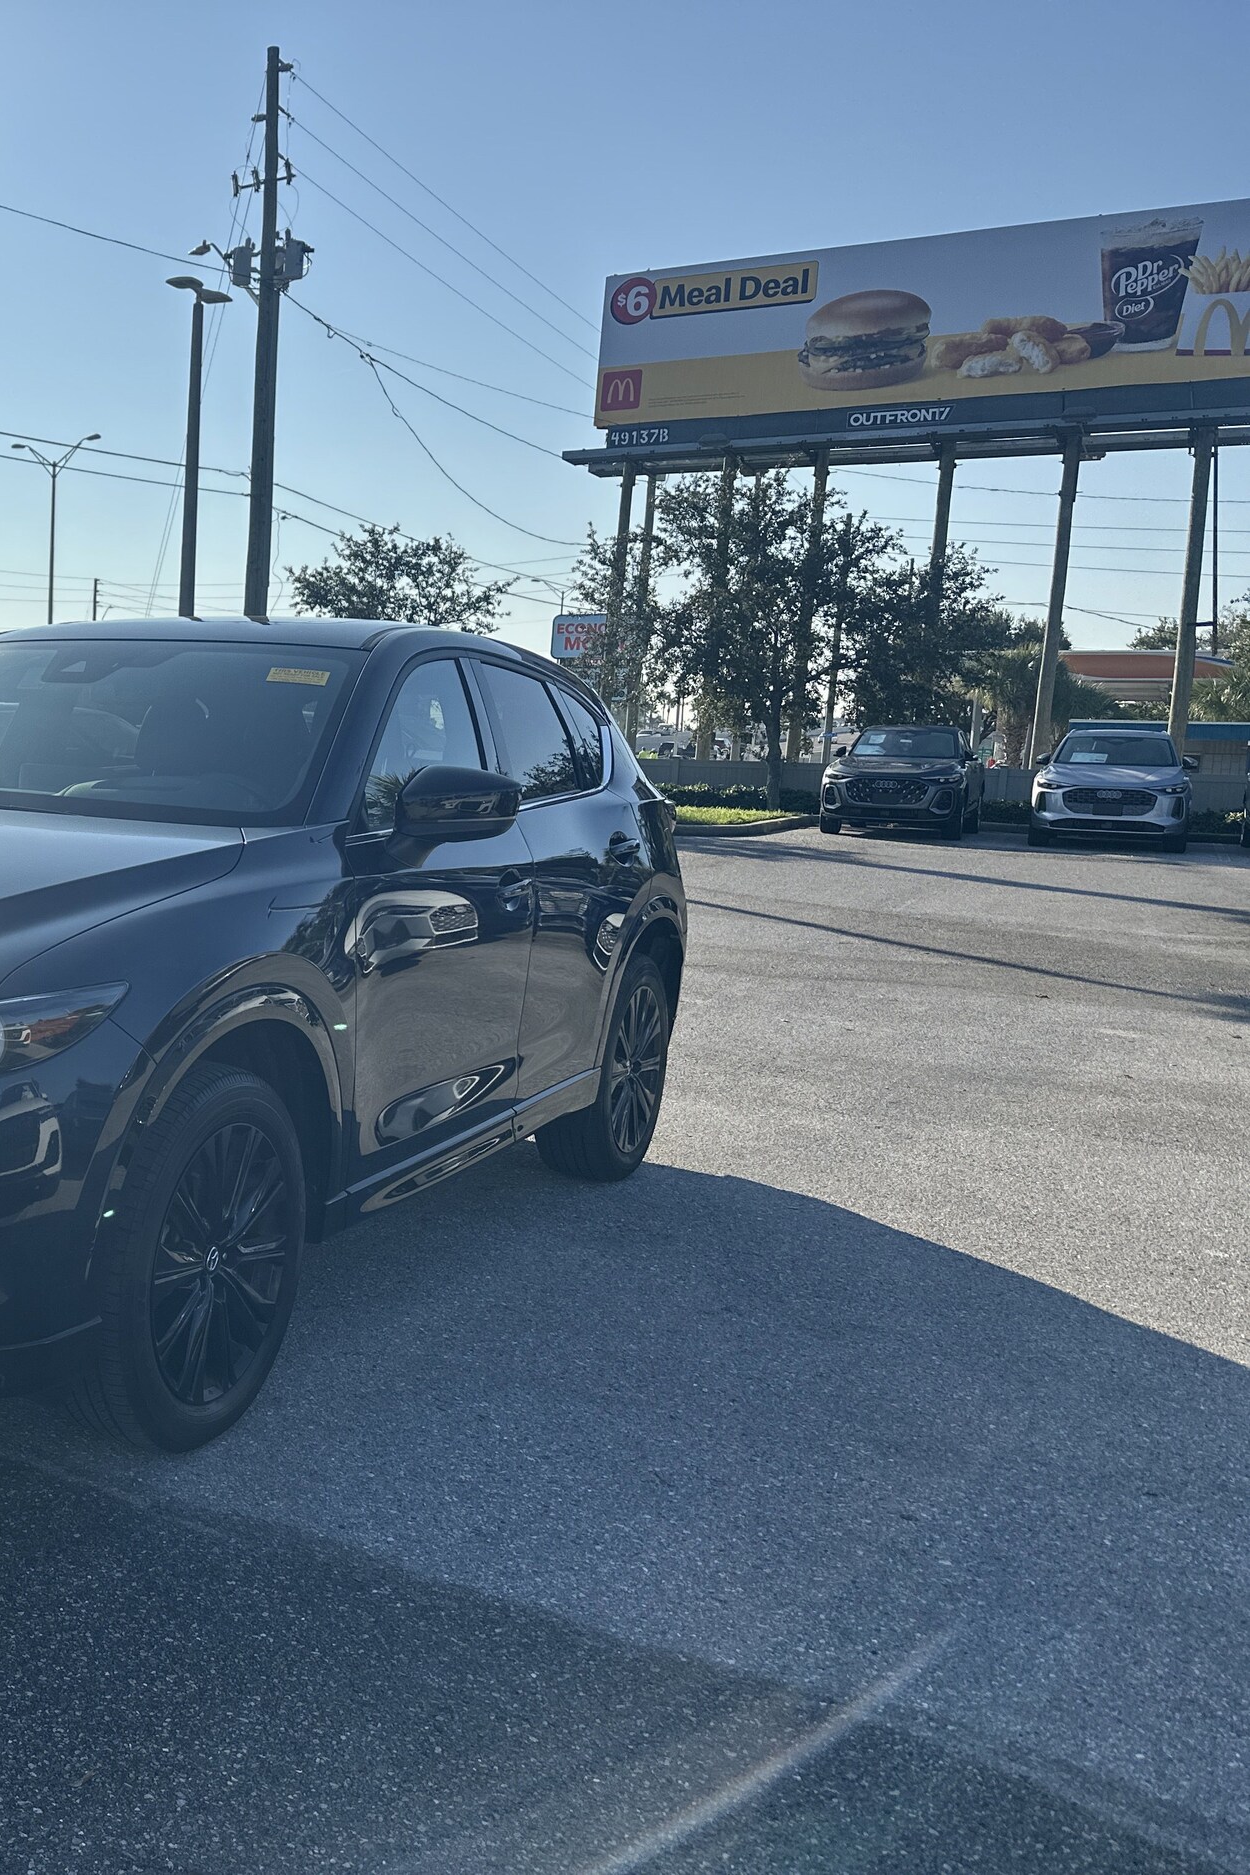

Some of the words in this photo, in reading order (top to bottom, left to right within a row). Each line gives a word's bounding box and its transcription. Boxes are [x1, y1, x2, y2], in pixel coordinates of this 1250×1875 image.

[1138, 260, 1163, 280] Dr
[1112, 263, 1179, 297] Pepper
[617, 285, 650, 317] $6
[658, 277, 732, 310] Meal
[738, 268, 810, 301] Deal
[1122, 301, 1146, 316] Diet
[611, 428, 669, 446] 49137B
[556, 622, 607, 635] ECONO
